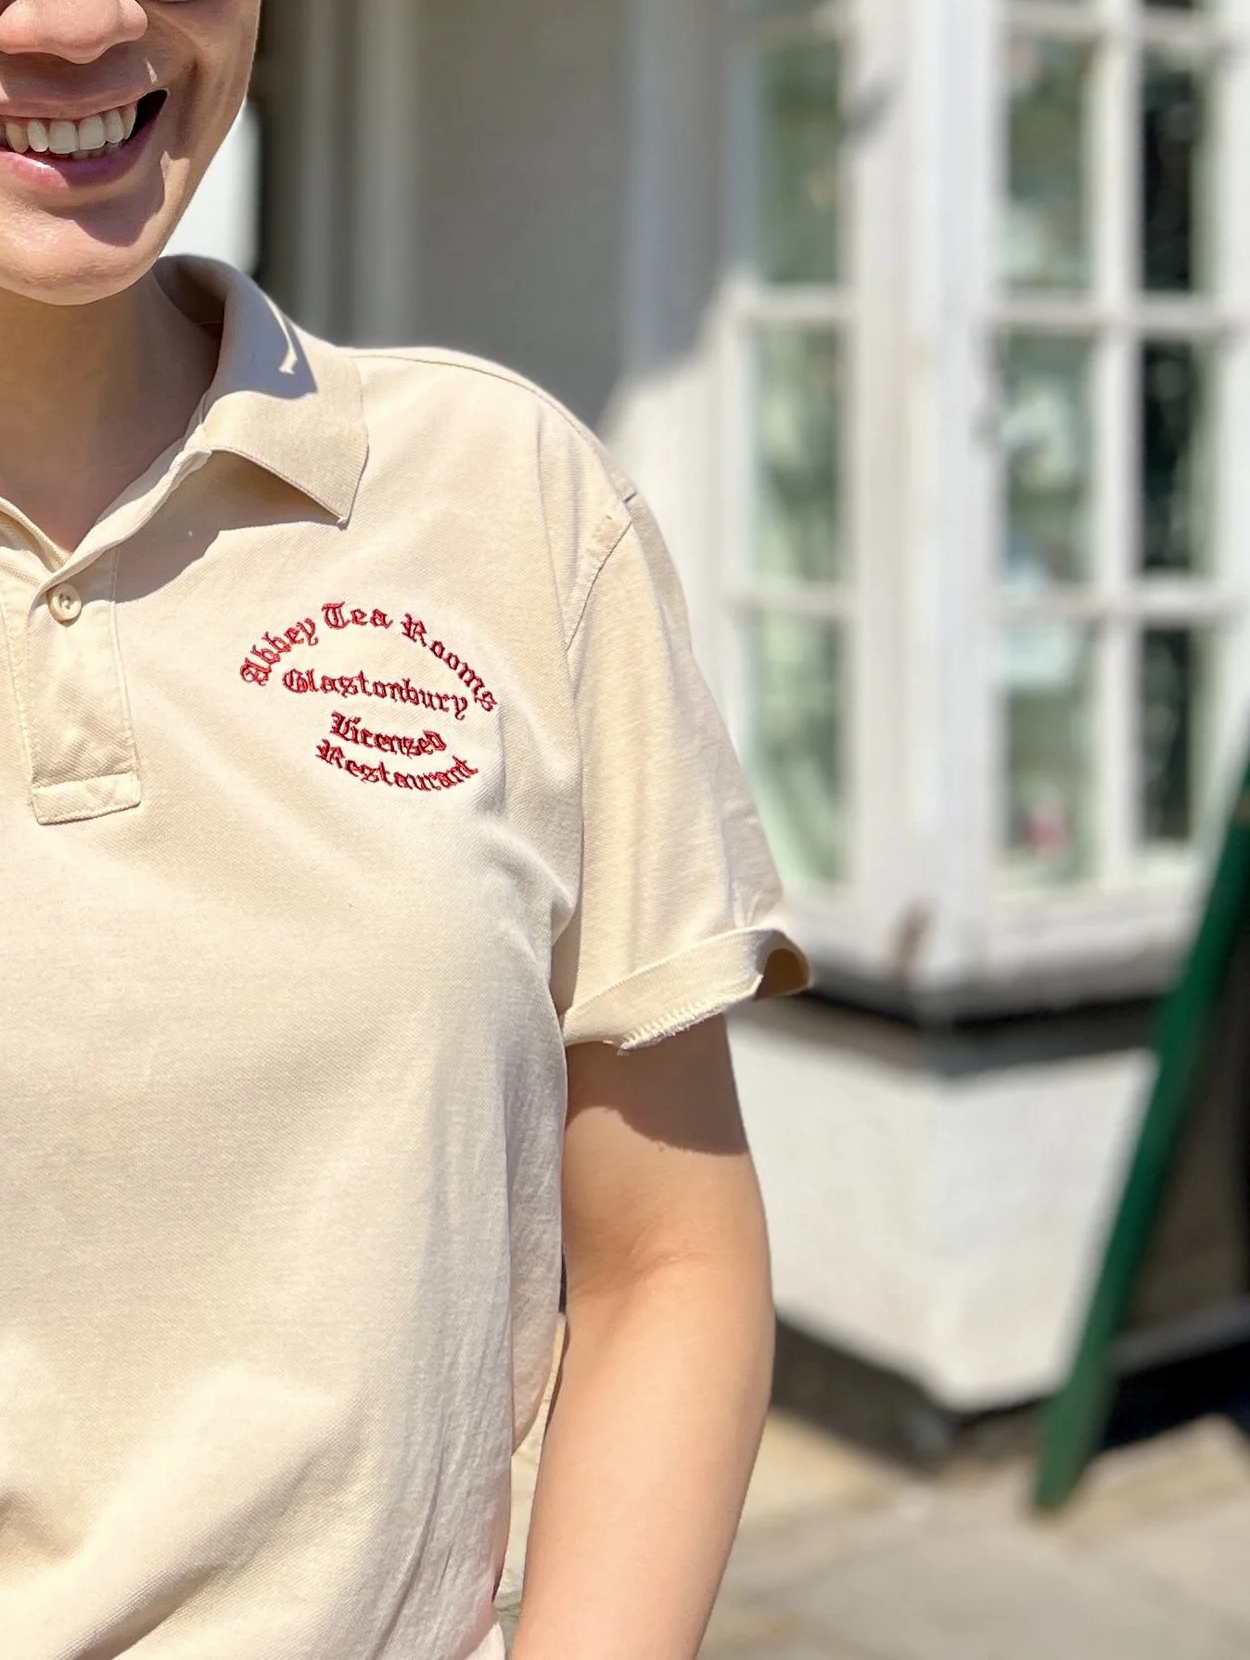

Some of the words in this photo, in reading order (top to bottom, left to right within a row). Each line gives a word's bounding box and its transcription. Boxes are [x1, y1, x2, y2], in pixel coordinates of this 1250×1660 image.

[239, 616, 319, 686] Abbey
[321, 601, 393, 630] Tea
[400, 613, 498, 712] Rooms
[282, 667, 469, 721] Glastonbury
[329, 711, 447, 758] Licensed
[315, 739, 479, 792] Restaurant
